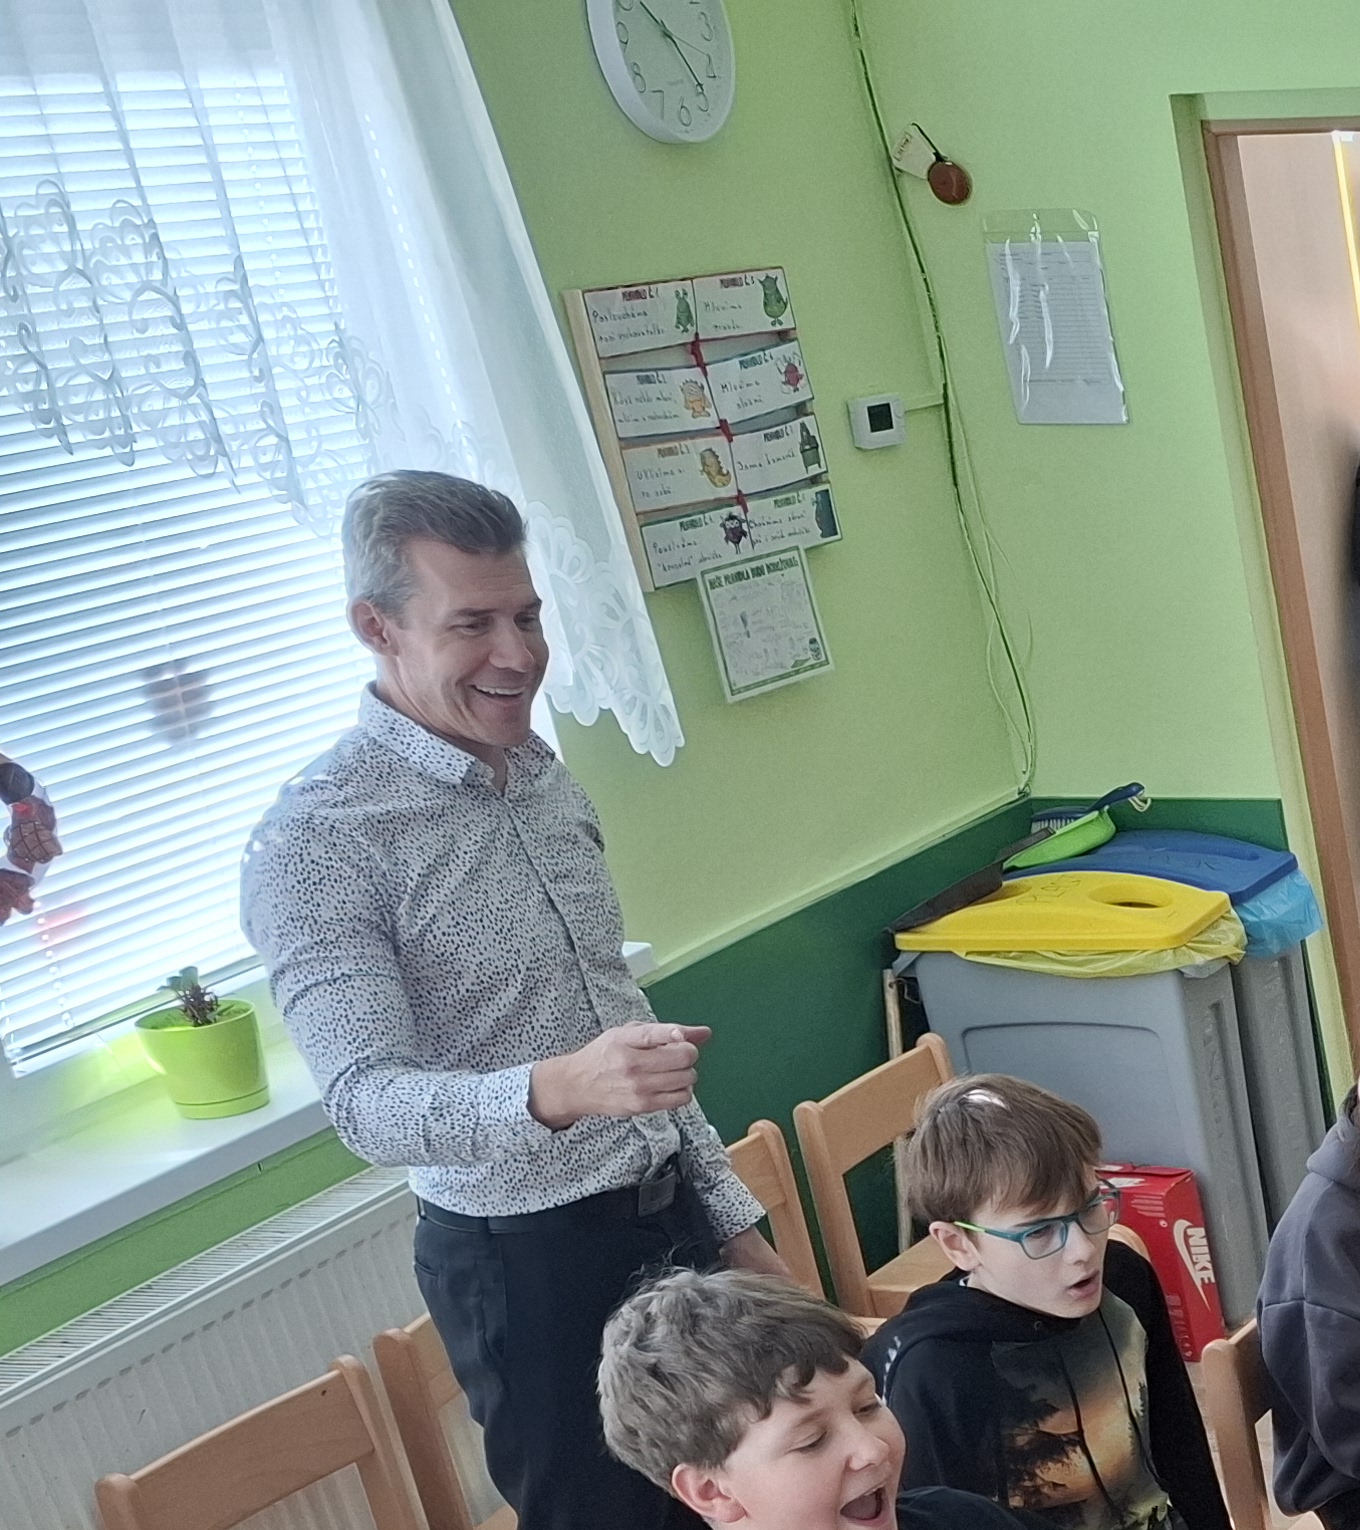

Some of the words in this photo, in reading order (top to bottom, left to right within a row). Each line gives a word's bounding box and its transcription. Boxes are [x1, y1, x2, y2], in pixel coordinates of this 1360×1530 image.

[616, 21, 629, 53] 9
[699, 11, 713, 41] 3
[632, 62, 646, 93] 8
[651, 89, 665, 121] 7
[680, 96, 692, 127] 6
[696, 83, 709, 112] 5
[1185, 1226, 1216, 1287] NIKE
